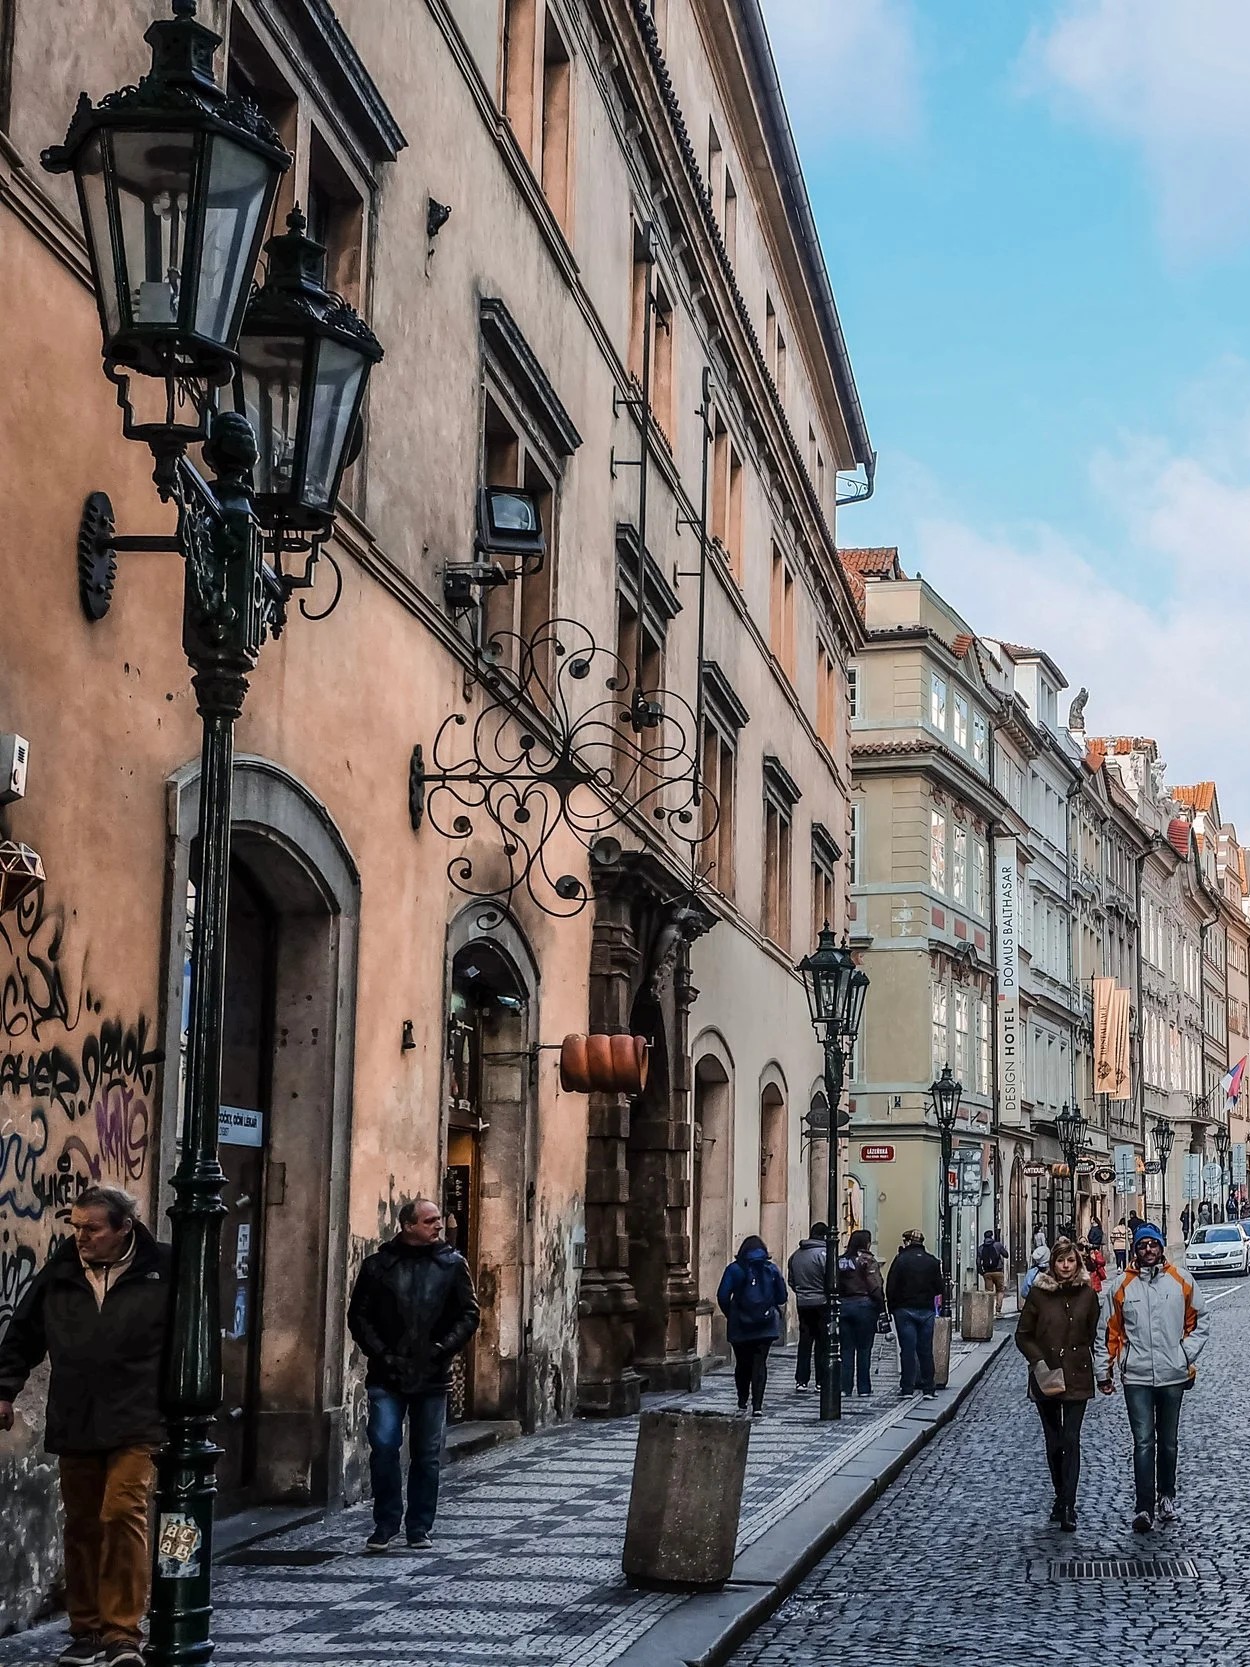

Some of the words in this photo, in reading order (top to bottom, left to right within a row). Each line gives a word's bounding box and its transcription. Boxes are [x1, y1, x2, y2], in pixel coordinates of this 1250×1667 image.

[1002, 866, 1013, 936] BALTHASAR
[1003, 937, 1014, 987] DOMUS
[1004, 1007, 1015, 1056] HOTEL
[1005, 1061, 1016, 1111] DESIGN
